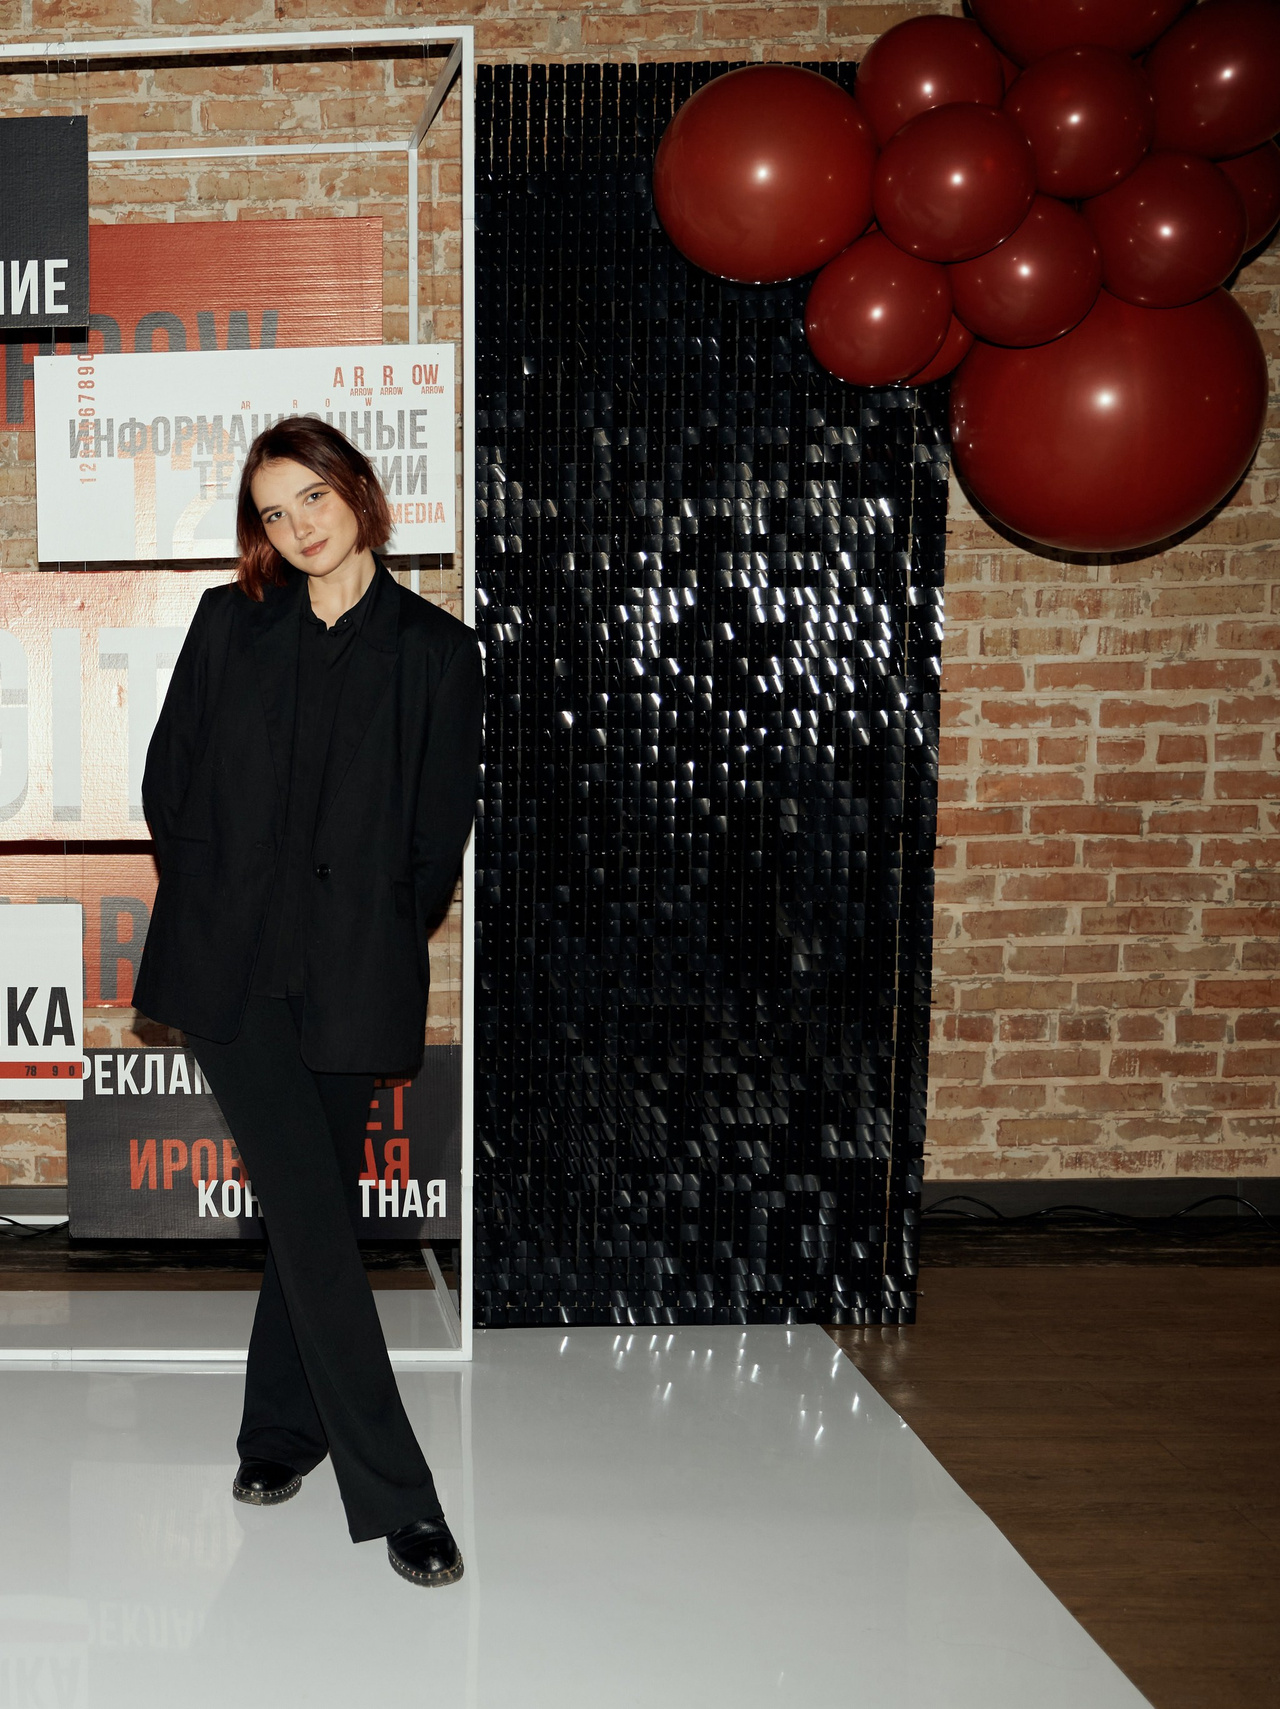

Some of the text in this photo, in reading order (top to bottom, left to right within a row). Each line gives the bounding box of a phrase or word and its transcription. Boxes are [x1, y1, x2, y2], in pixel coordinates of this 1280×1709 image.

[350, 386, 444, 396] ARROW ARROW ARROW
[69, 409, 427, 459] ИНФОРМАНЫЕ
